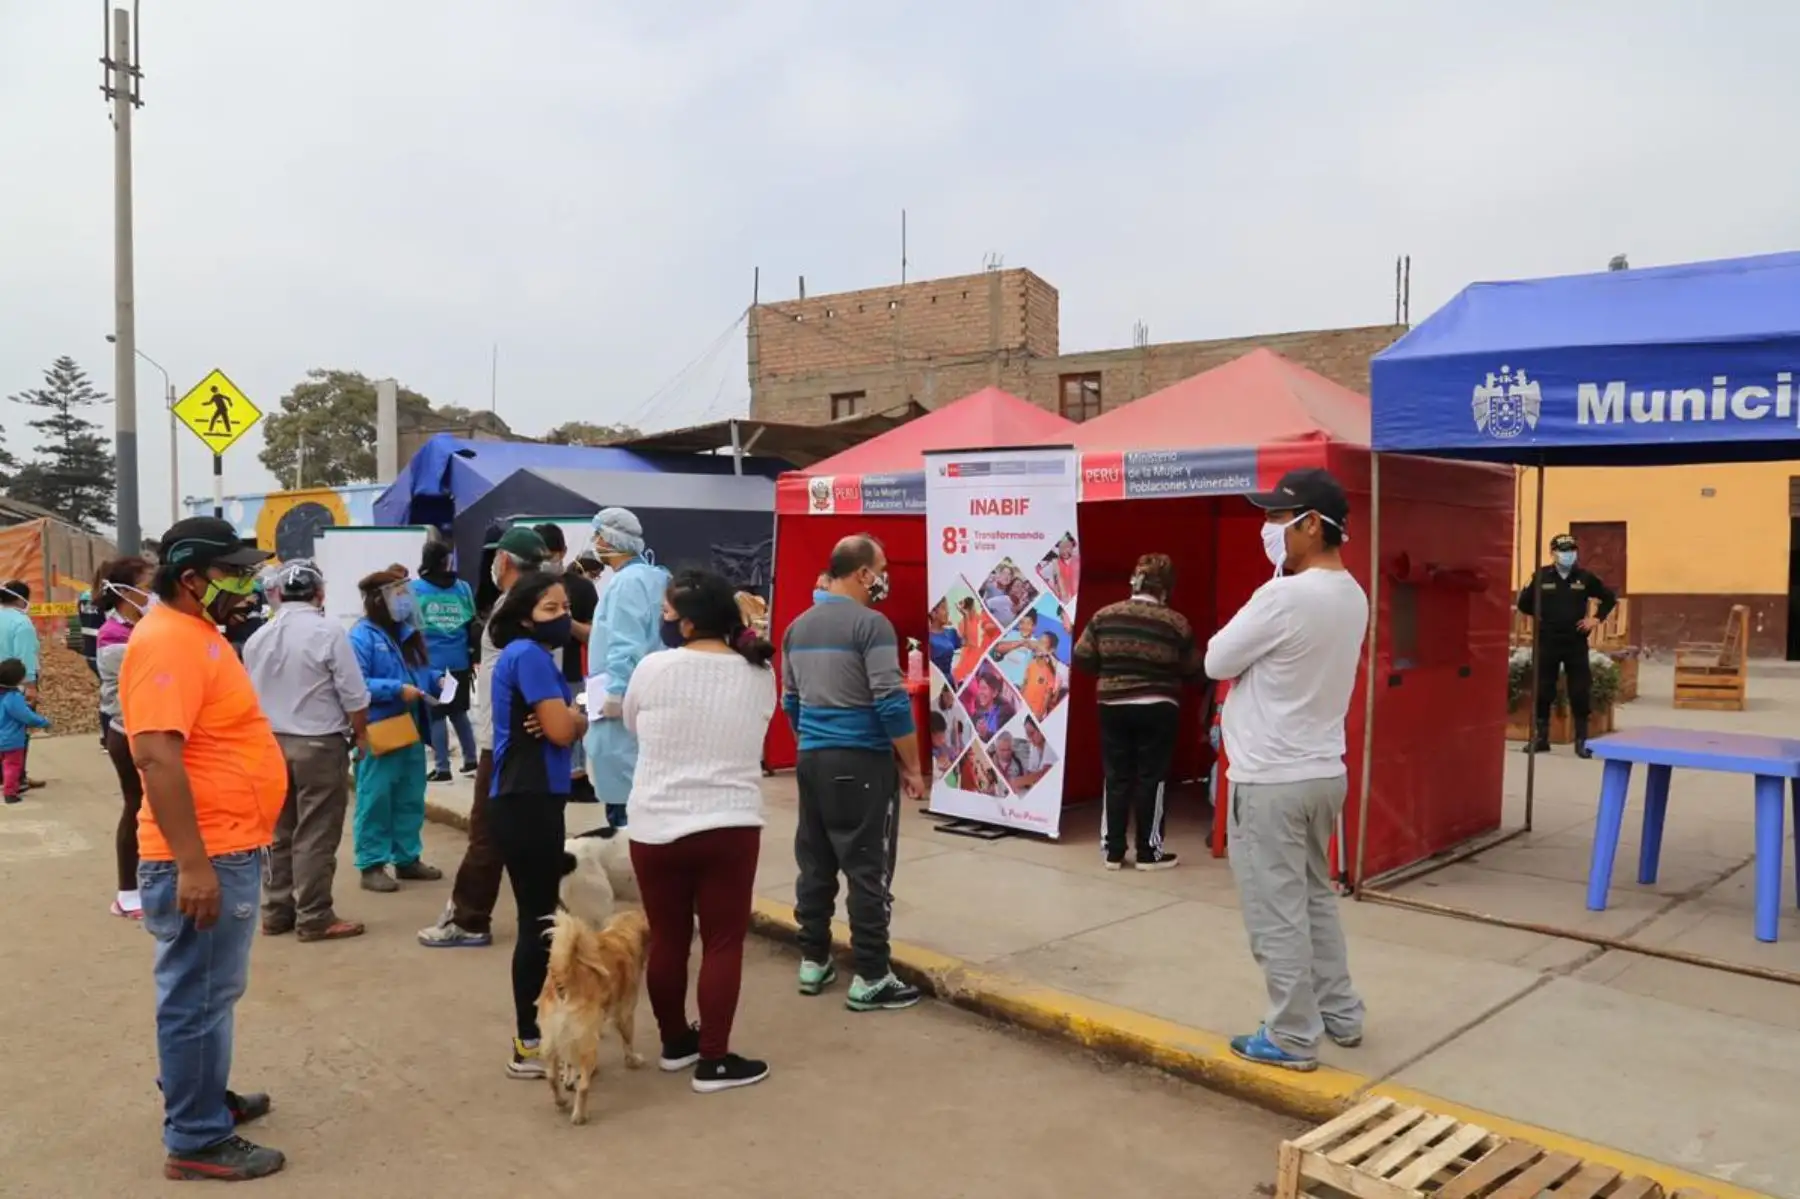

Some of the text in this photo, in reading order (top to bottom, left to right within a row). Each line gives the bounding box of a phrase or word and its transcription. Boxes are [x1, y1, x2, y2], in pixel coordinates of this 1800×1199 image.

[1577, 372, 1800, 429] Munici
[1153, 464, 1184, 480] Mujer
[1129, 473, 1250, 494] Poblaciones Vulnerables
[970, 498, 1030, 516] INABIF
[974, 530, 1045, 541] Transformando
